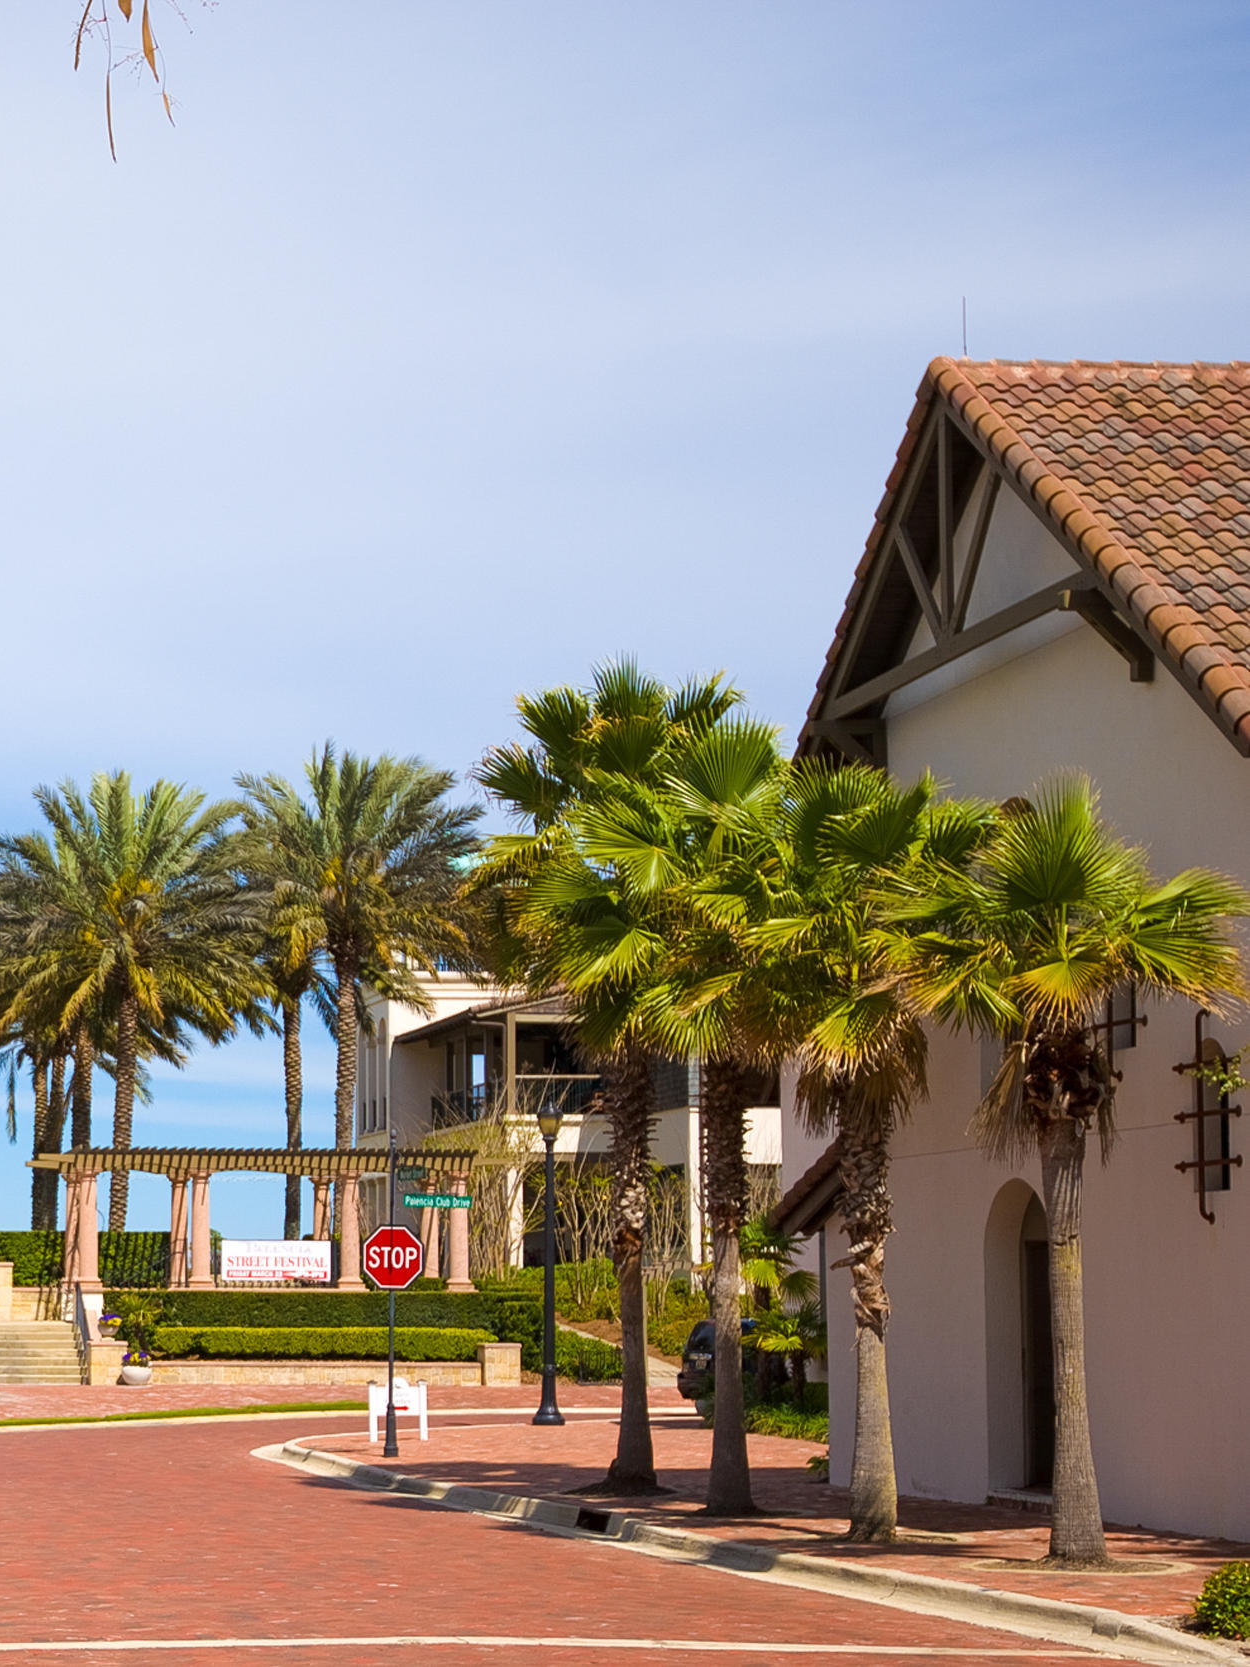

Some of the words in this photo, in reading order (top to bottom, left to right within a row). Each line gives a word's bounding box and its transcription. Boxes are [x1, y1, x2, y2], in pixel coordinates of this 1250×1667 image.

[405, 1195, 434, 1206] Palencia
[436, 1196, 451, 1207] Club
[452, 1197, 471, 1208] Drive
[227, 1256, 270, 1267] STREET
[274, 1256, 328, 1268] FESTIVAL
[368, 1245, 418, 1269] STOP
